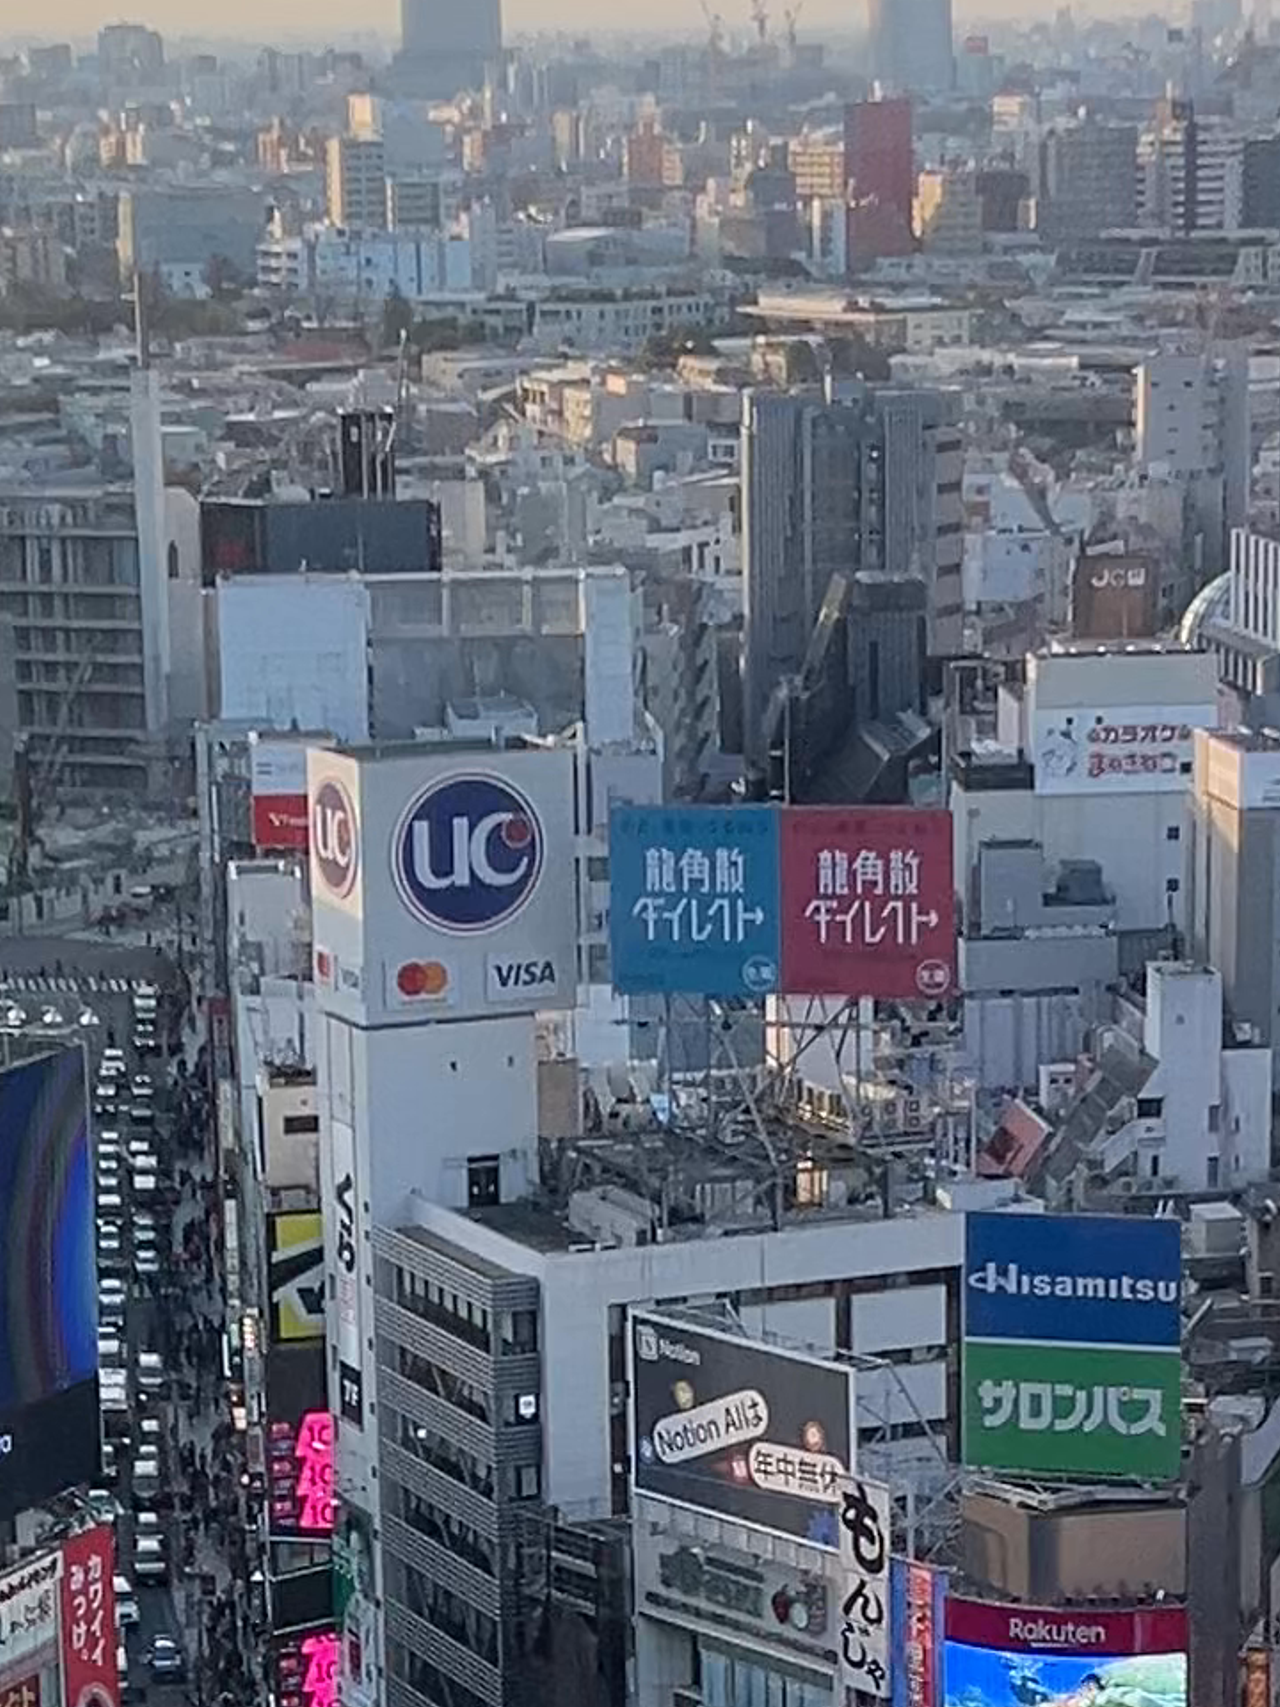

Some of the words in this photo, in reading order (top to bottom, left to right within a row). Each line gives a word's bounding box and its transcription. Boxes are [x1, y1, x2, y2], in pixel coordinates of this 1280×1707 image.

[644, 846, 746, 895] 龍角散
[817, 848, 921, 896] 龍角散
[631, 896, 766, 943] ダイレクト
[803, 898, 940, 946] ダイレクト
[494, 960, 556, 988] VISA
[968, 1261, 1179, 1303] Hisamitsu
[977, 1378, 1168, 1438] サロンパス
[656, 1414, 722, 1457] Notion
[841, 1480, 887, 1692] もんじゃ
[86, 1553, 106, 1668] カワイイ
[1008, 1617, 1107, 1644] Rakuten
